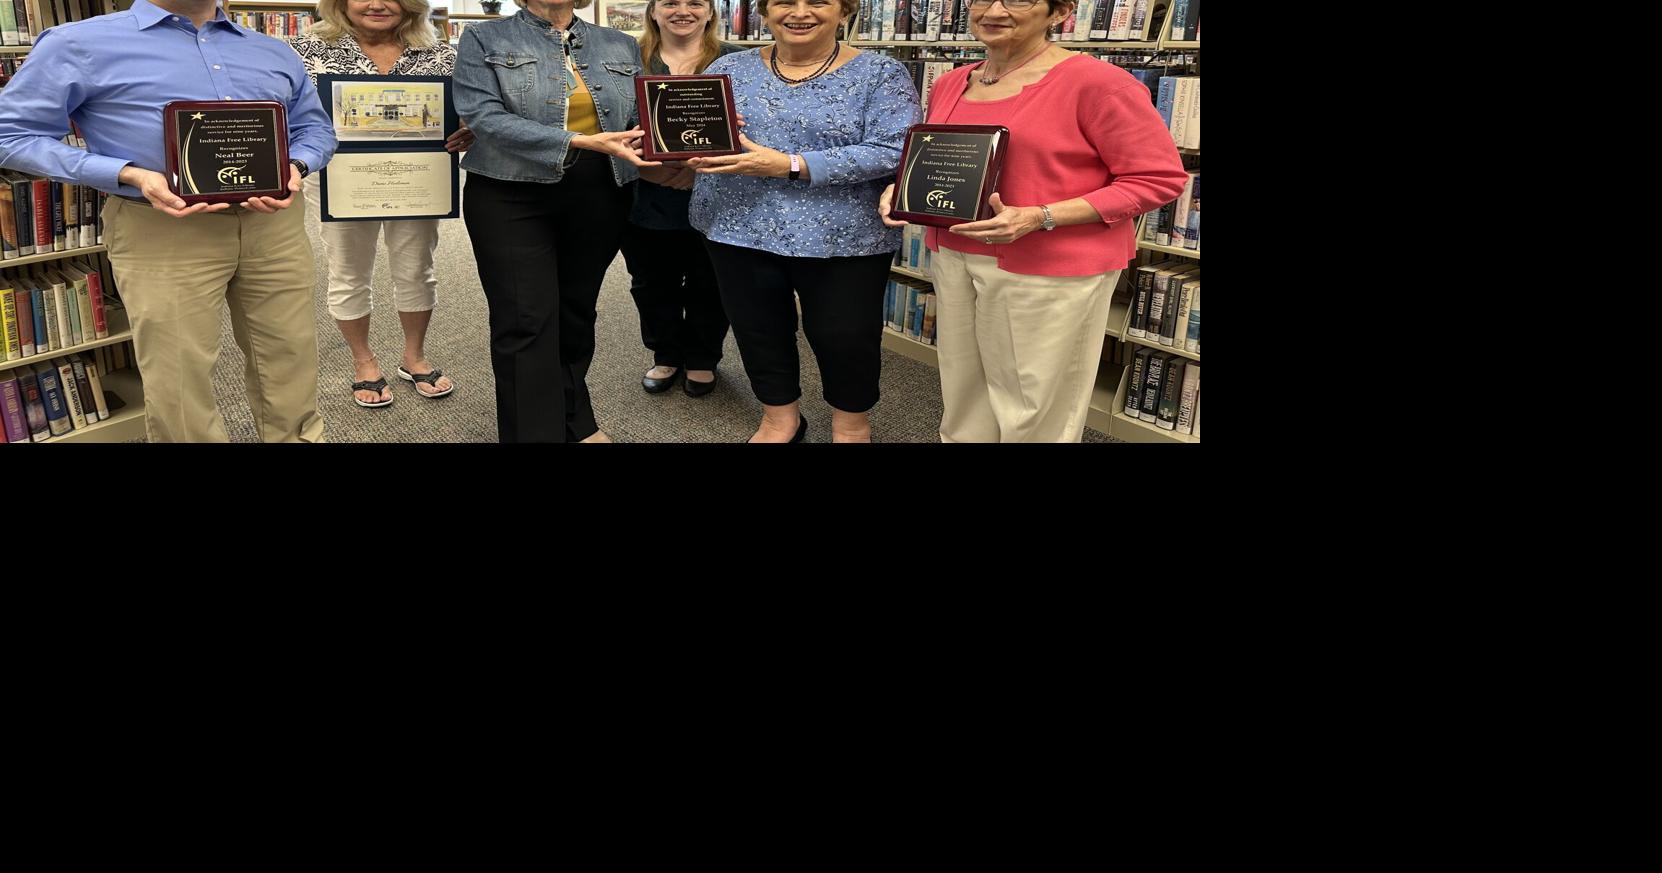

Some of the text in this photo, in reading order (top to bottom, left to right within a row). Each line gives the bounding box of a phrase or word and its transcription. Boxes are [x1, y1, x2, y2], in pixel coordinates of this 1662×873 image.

[1132, 358, 1142, 391] DEAN KOONTZ
[67, 378, 75, 392] JACK
[71, 390, 81, 416] ANDERSON
